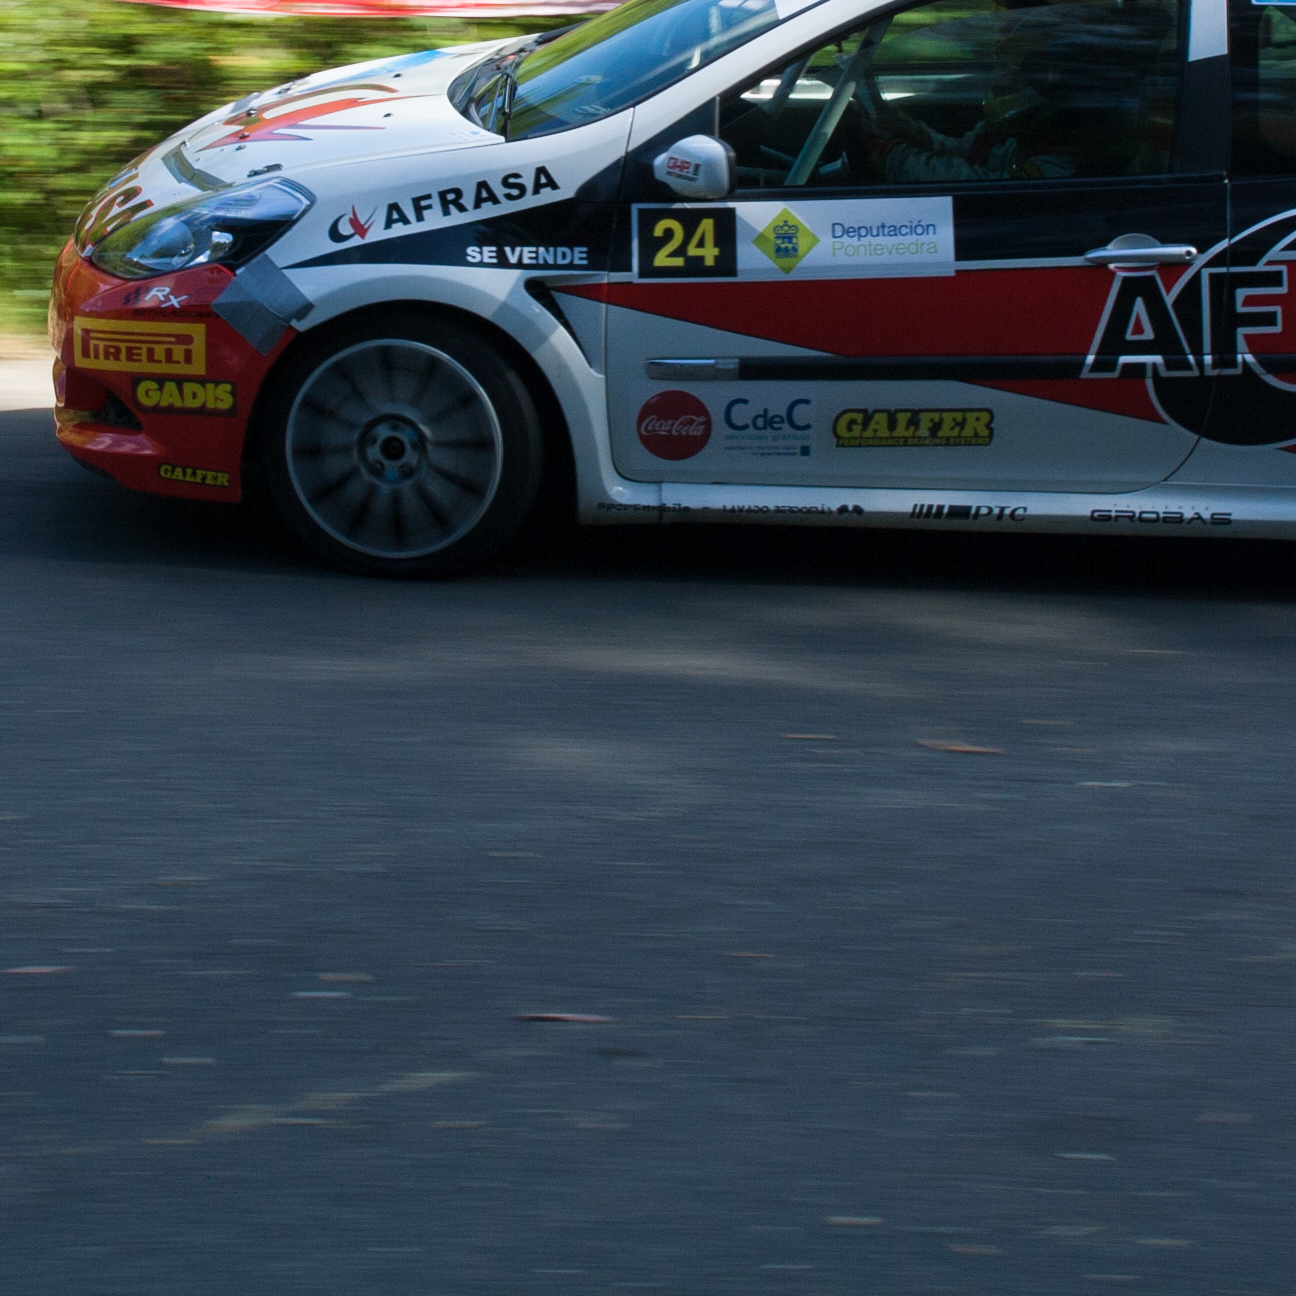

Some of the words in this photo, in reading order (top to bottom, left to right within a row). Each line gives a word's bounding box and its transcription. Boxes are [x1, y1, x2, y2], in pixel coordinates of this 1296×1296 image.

[382, 166, 561, 231] AFRASA
[652, 218, 720, 267] 24
[832, 219, 937, 241] Deputación
[466, 246, 498, 264] SE
[505, 247, 589, 265] VENDE
[832, 240, 939, 259] Pontevedra
[81, 328, 195, 365] PIRELLI
[136, 380, 234, 410] GADIS
[724, 398, 812, 431] CdeC
[836, 412, 992, 438] GALFER
[160, 464, 230, 488] GALFER
[972, 505, 1029, 523] PTC
[1090, 509, 1233, 525] GROBAS
